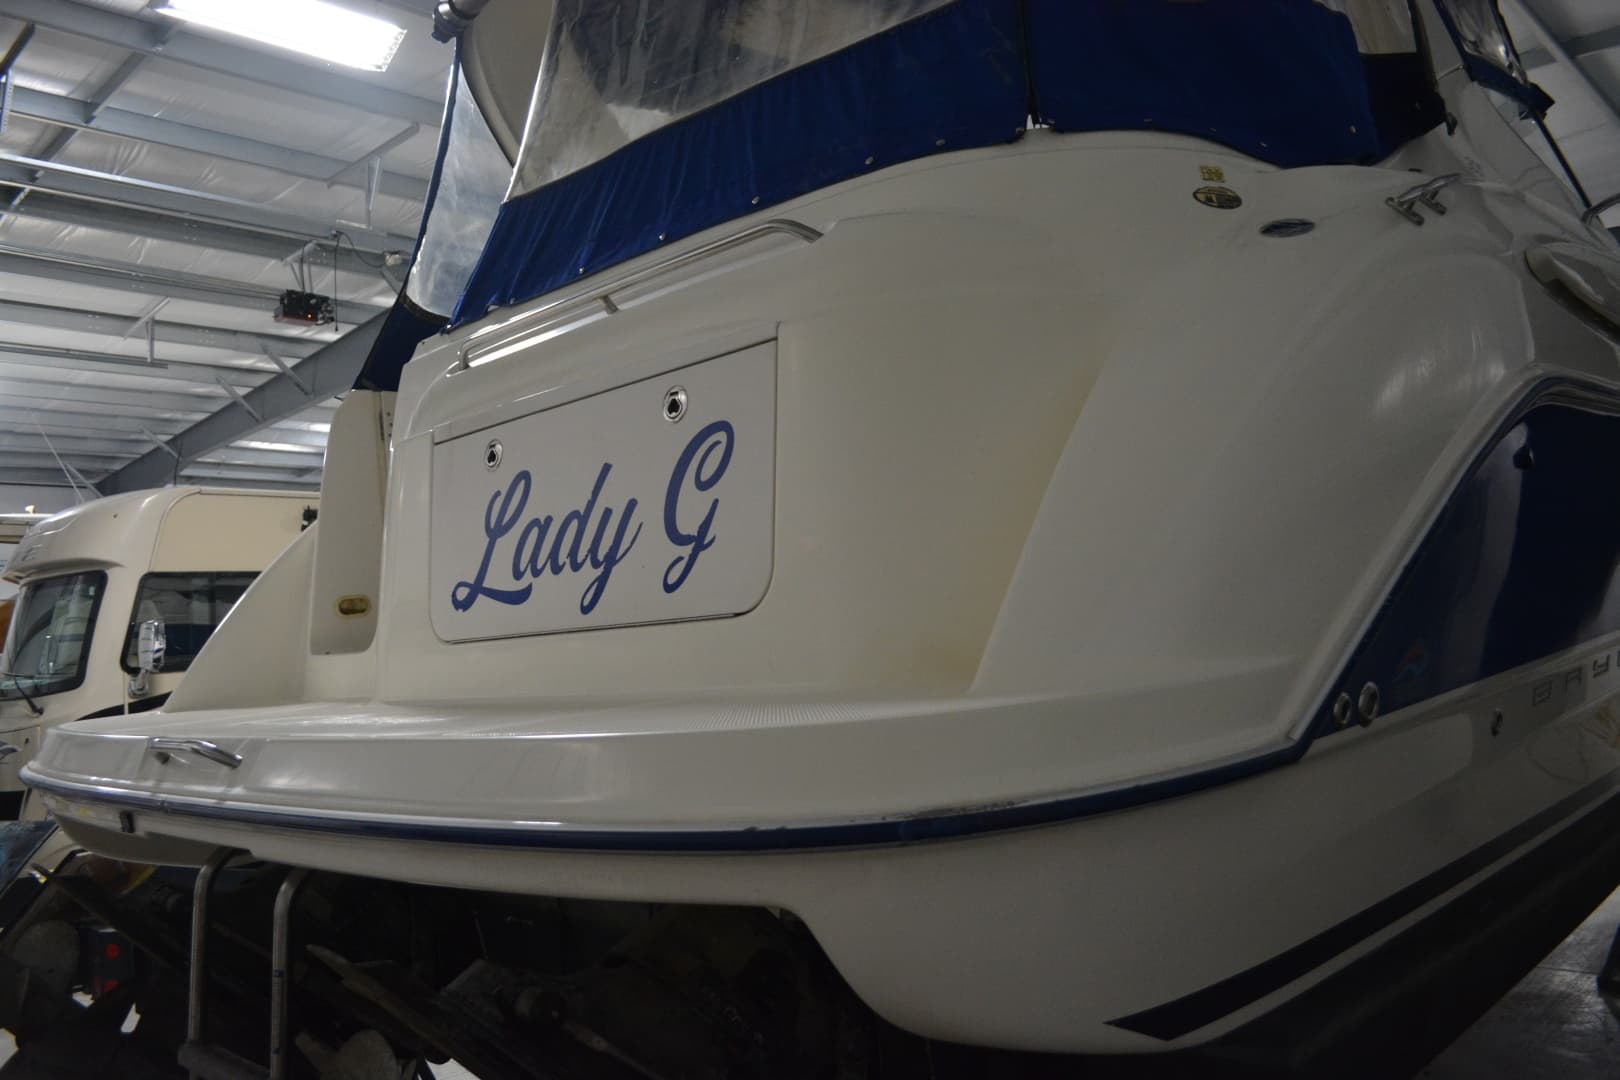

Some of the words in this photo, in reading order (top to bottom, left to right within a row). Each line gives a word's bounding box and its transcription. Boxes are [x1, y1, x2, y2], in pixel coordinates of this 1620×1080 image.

[452, 462, 643, 615] Lady
[663, 420, 734, 594] G
[1532, 650, 1620, 706] BAY
